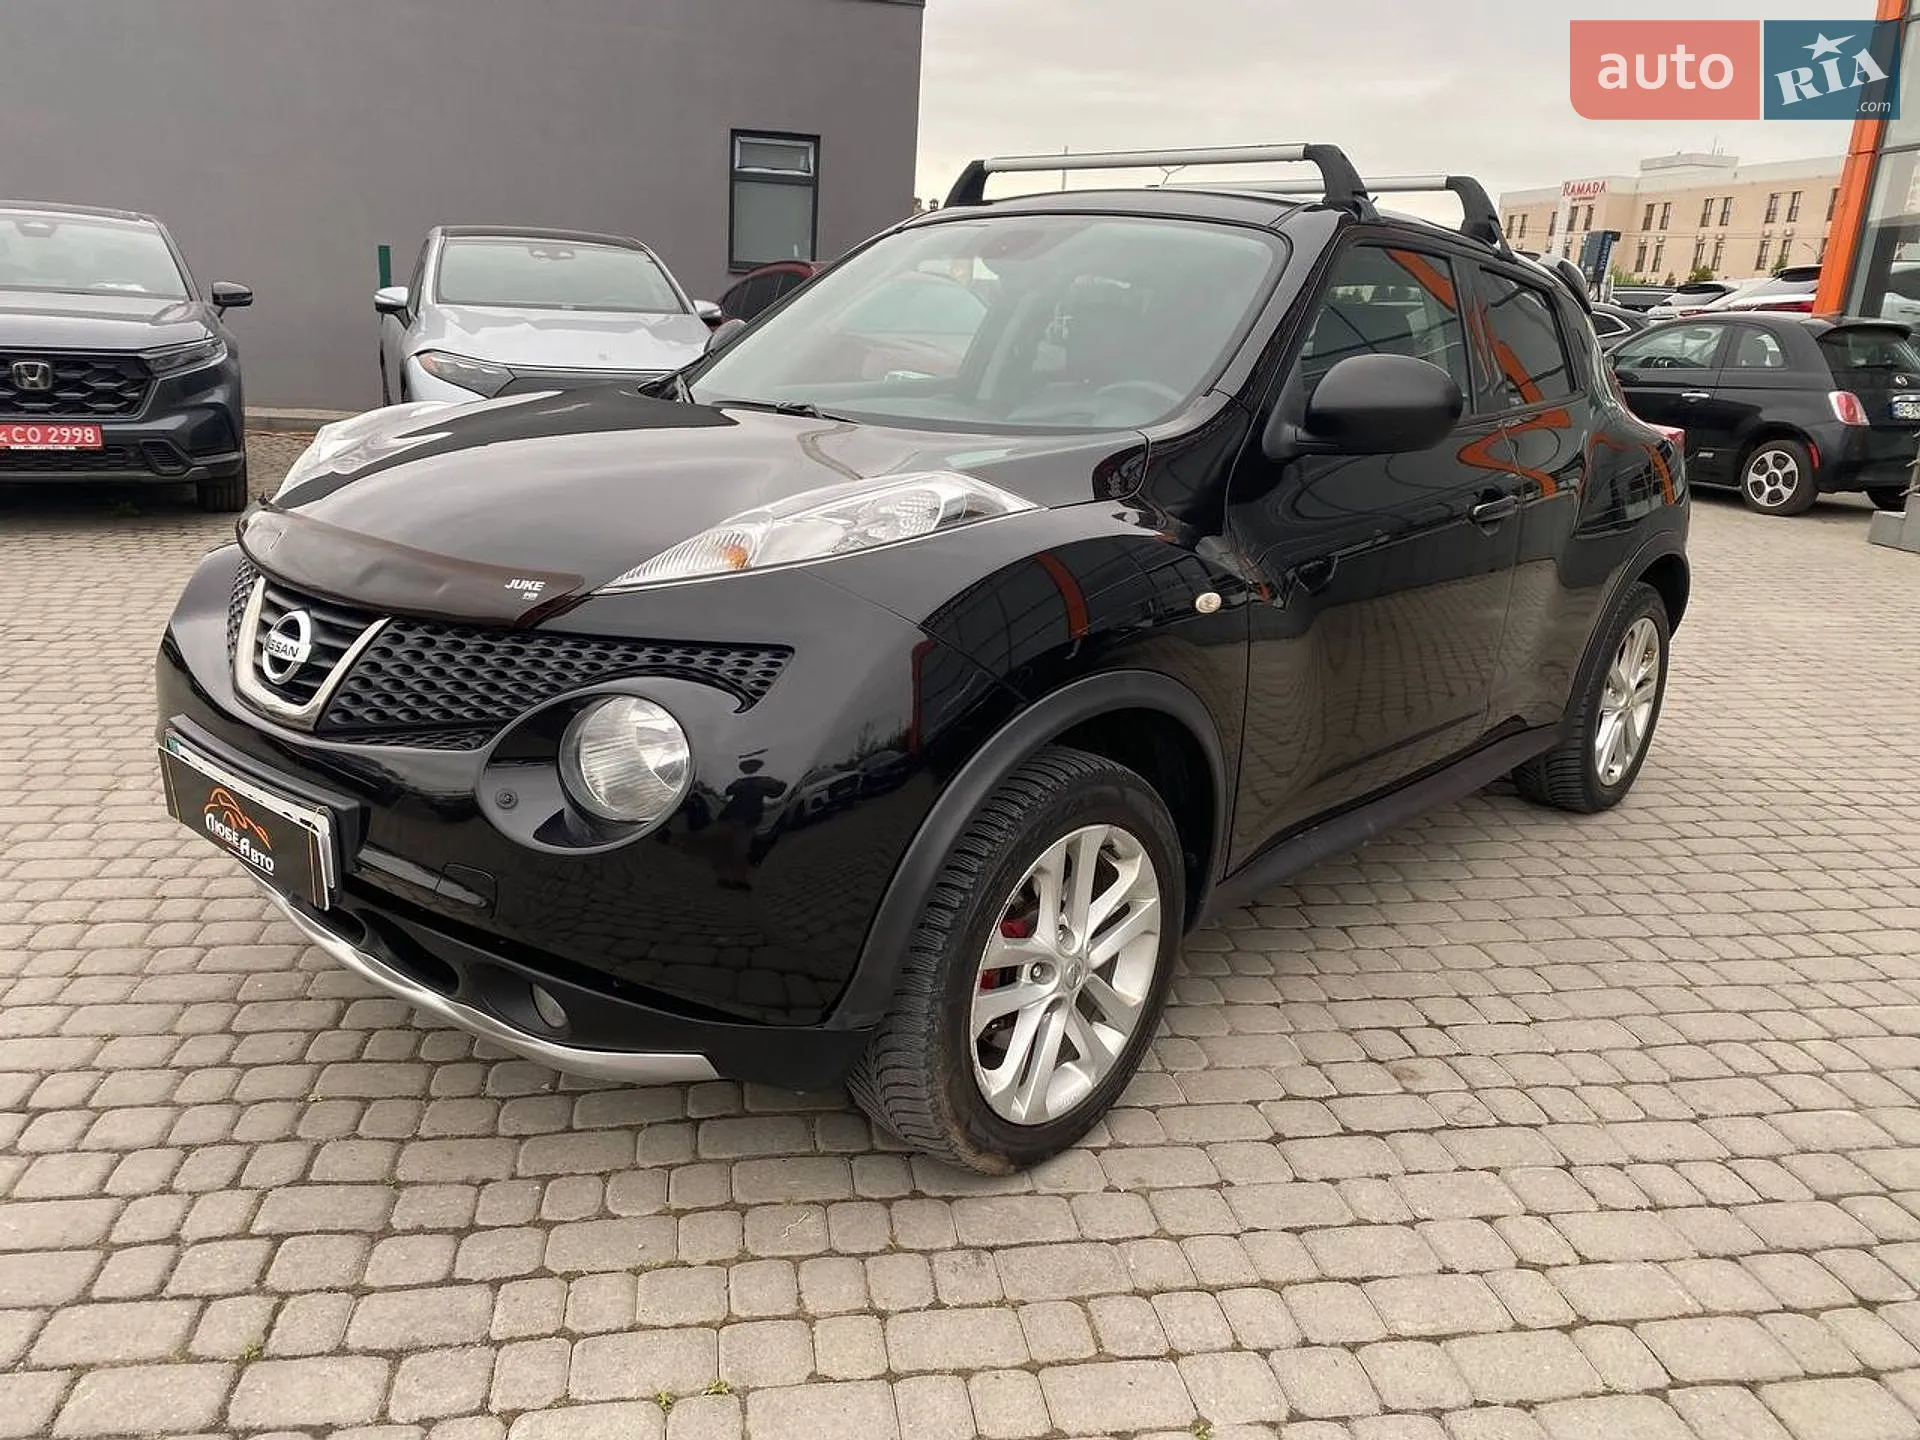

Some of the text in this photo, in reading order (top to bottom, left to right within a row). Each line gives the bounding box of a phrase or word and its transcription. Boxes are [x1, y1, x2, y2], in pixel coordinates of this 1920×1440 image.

[1562, 180, 1607, 196] RAMADA
[11, 426, 41, 443] CO
[47, 426, 95, 444] 2998
[504, 578, 546, 591] JUKE
[266, 638, 300, 658] SSAN
